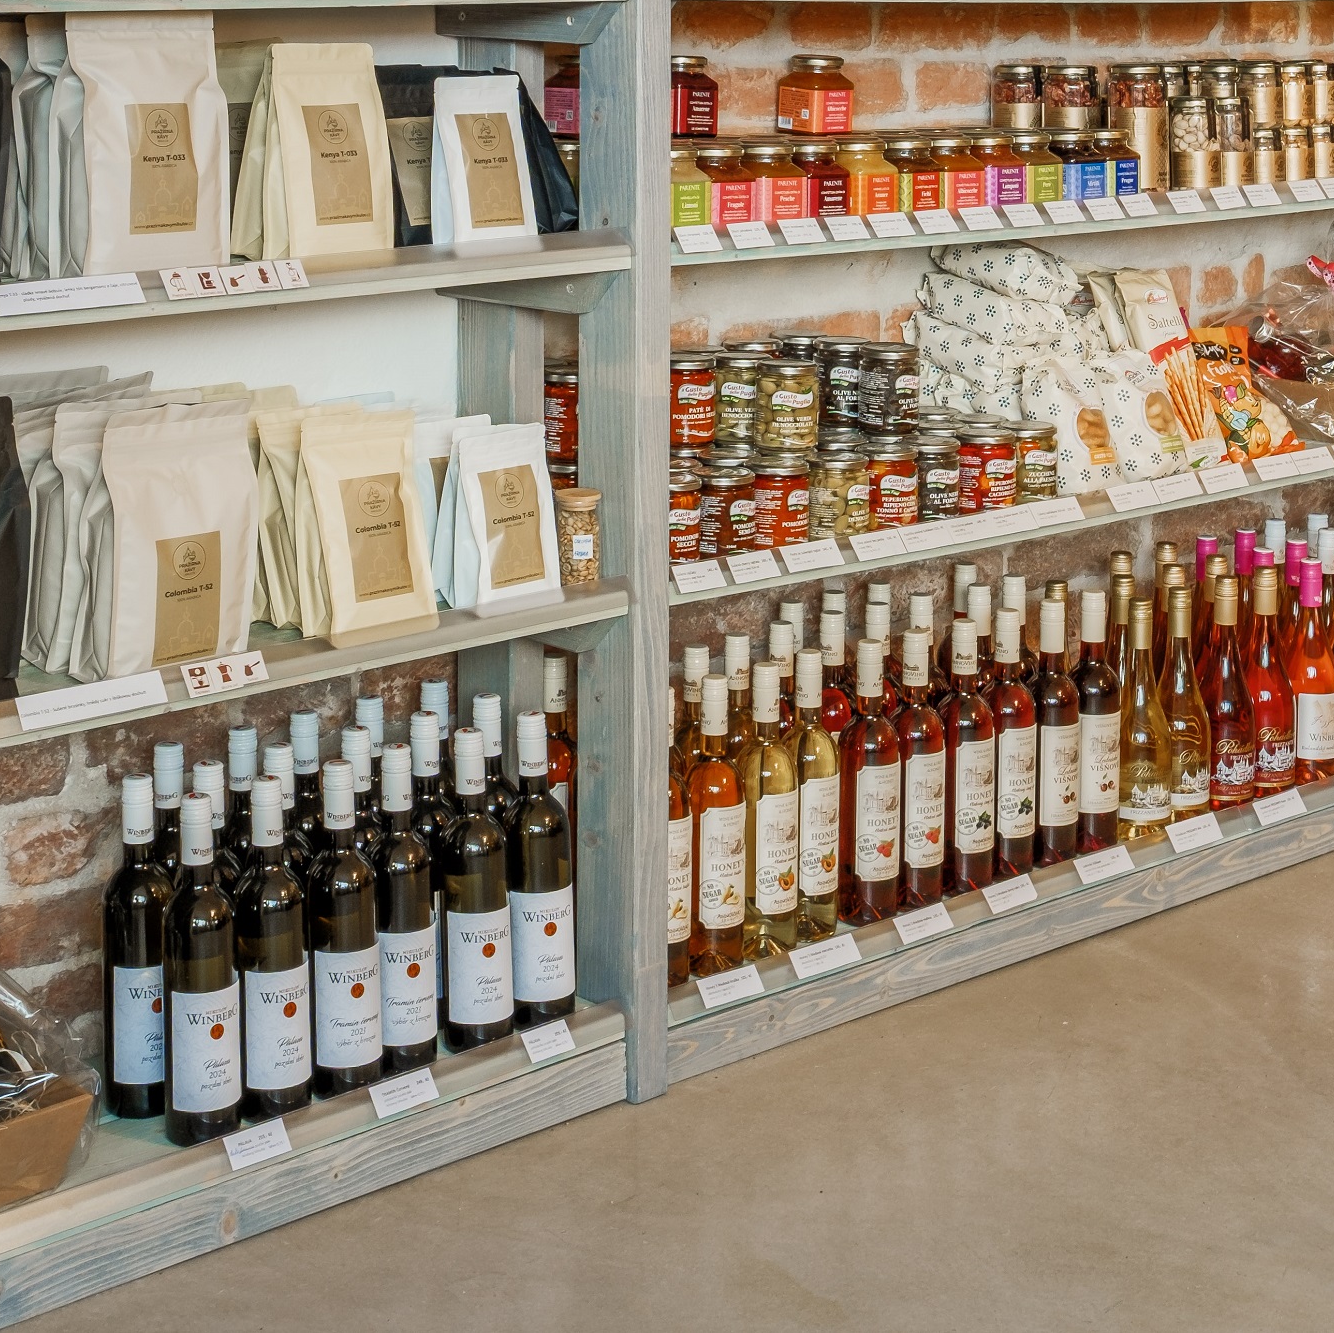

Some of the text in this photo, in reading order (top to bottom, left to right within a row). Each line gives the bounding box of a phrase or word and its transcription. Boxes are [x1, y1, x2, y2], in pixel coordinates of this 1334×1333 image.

[143, 155, 165, 163] Kenya
[493, 511, 534, 525] Colombia T-52
[356, 521, 400, 534] Colombia T-52
[165, 583, 213, 598] Colombia T-52
[523, 905, 571, 922] WINBERG
[461, 925, 509, 943] WINBERG
[385, 944, 434, 964] WINBERG
[328, 964, 378, 984] WINBERG
[481, 986, 497, 995] 2024
[187, 1003, 237, 1025] WINBERG
[283, 1047, 299, 1056] 2024
[209, 1069, 226, 1079] 2024
